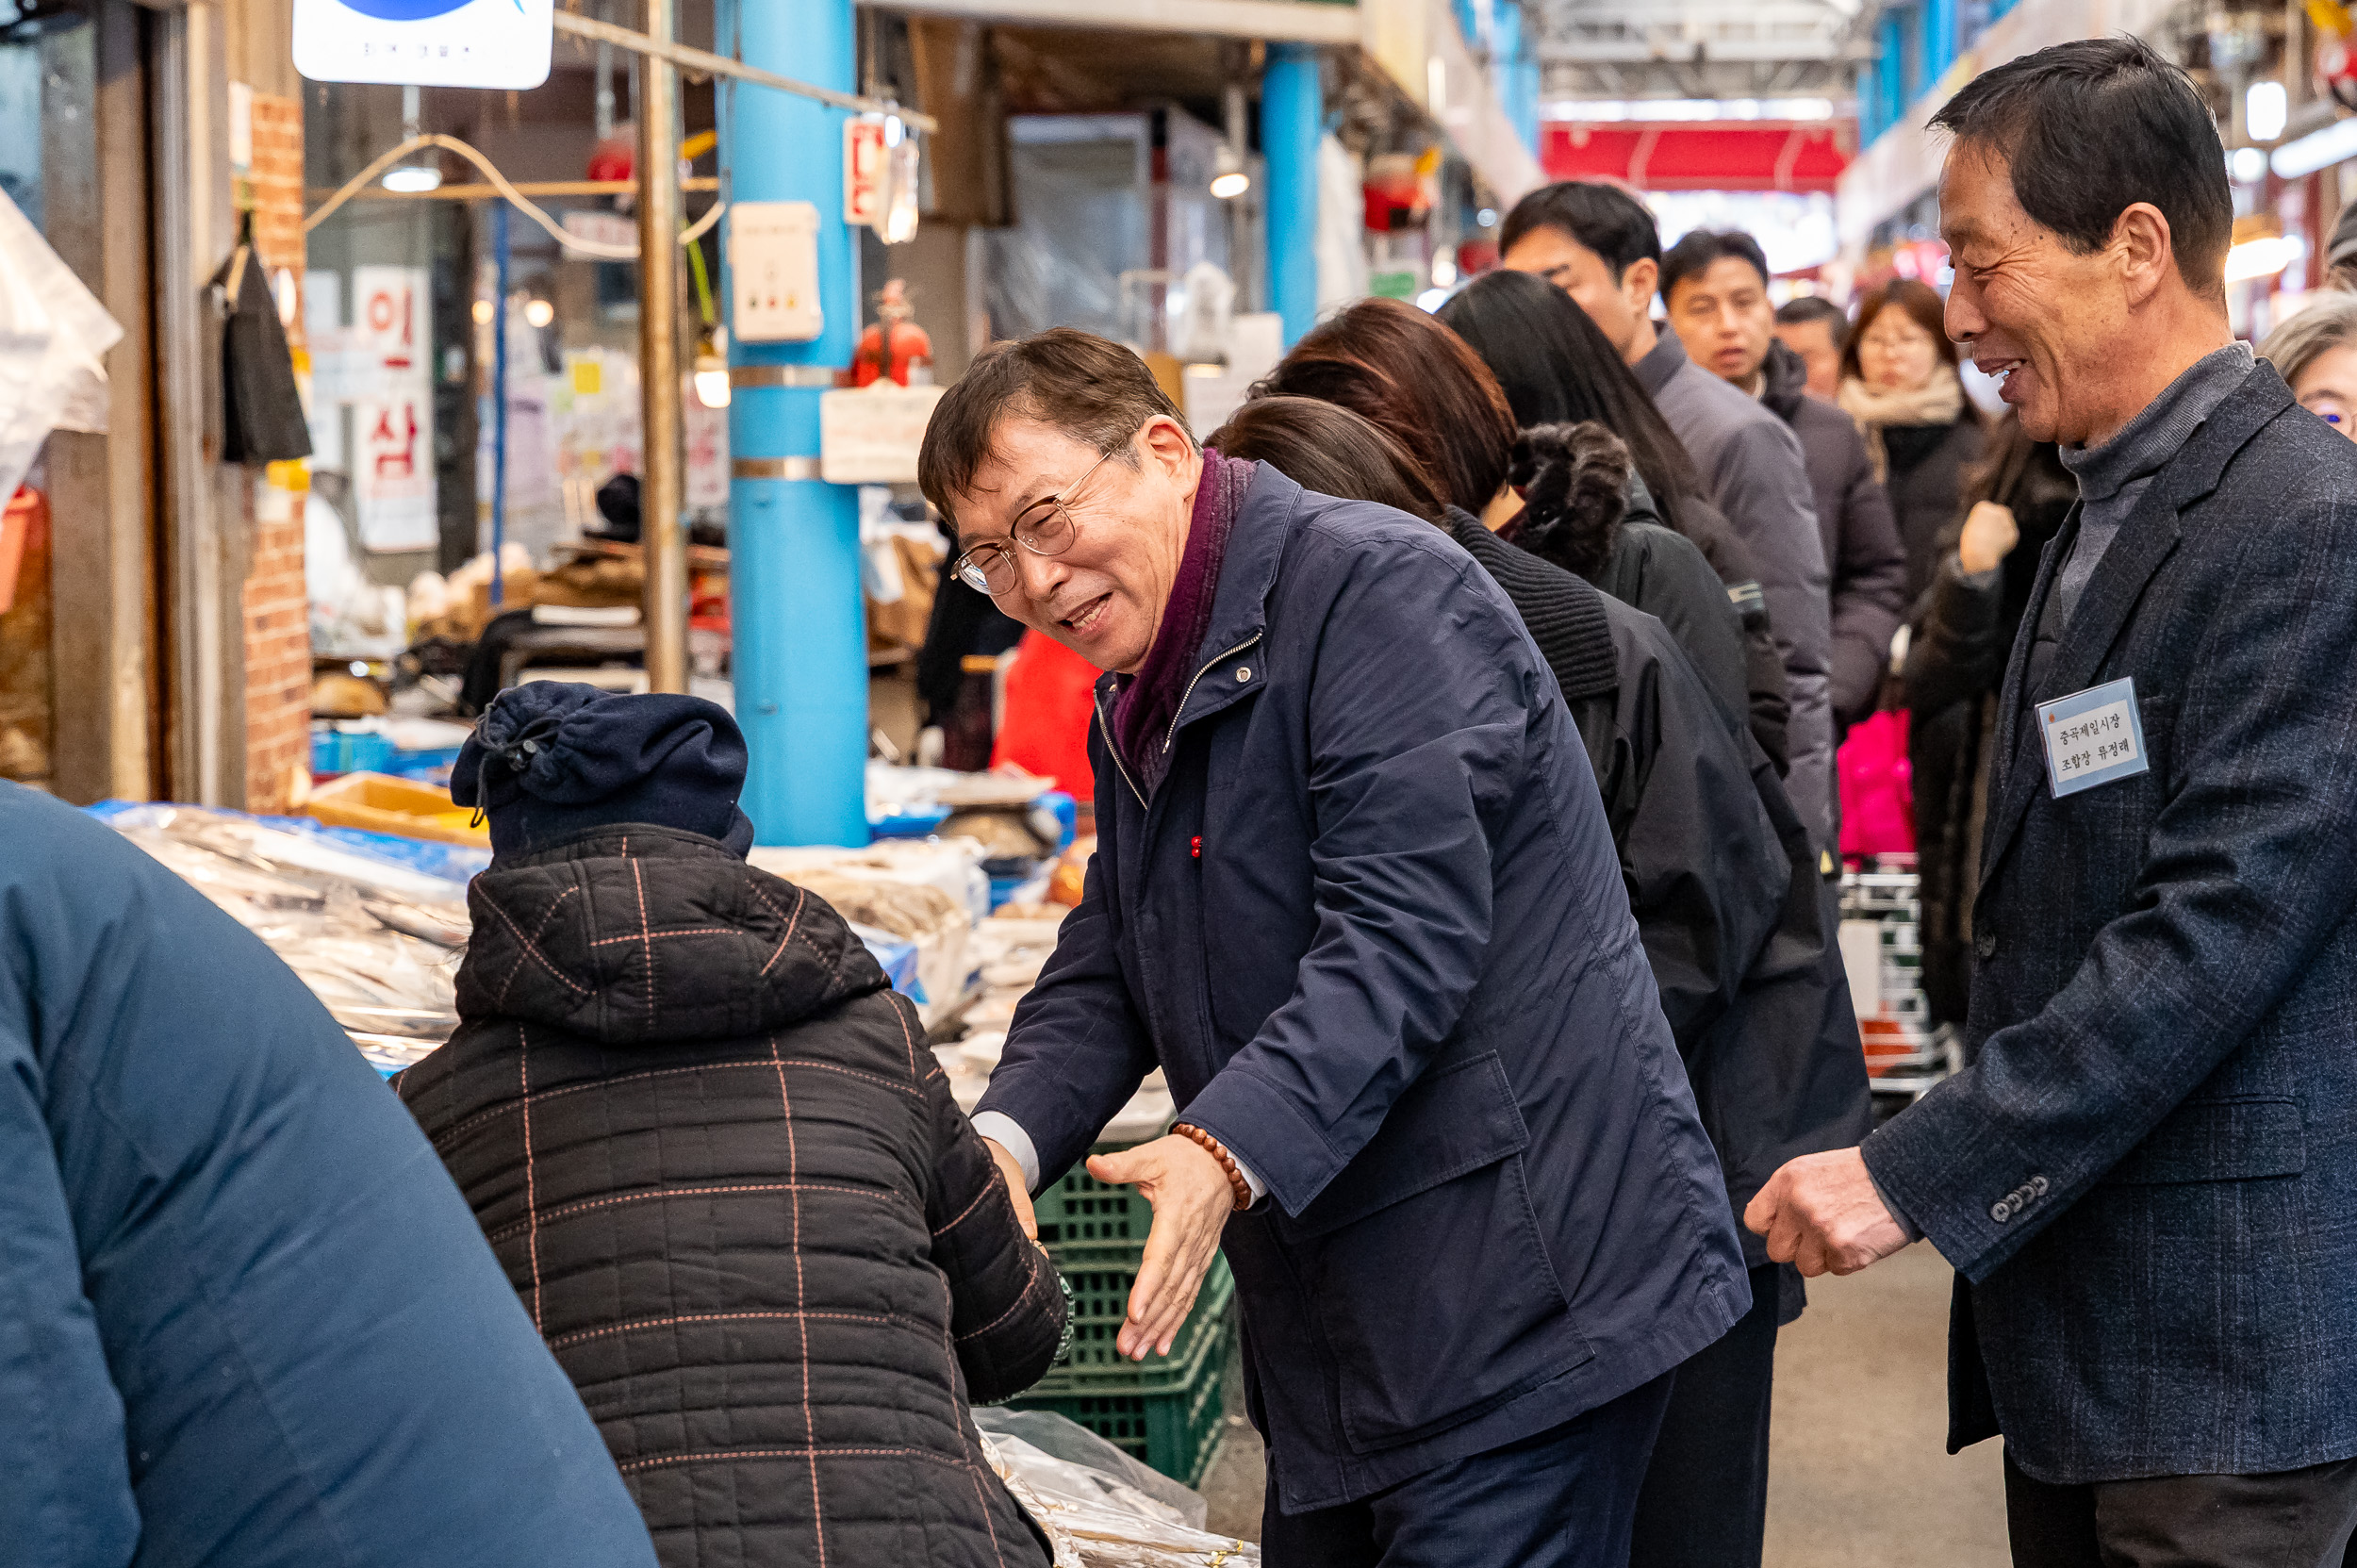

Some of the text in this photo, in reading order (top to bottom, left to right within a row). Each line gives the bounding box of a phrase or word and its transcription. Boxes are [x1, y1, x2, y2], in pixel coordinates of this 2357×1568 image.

[2059, 713, 2120, 746] 중곡제일시장
[2061, 738, 2130, 771] 조합장 류정래
